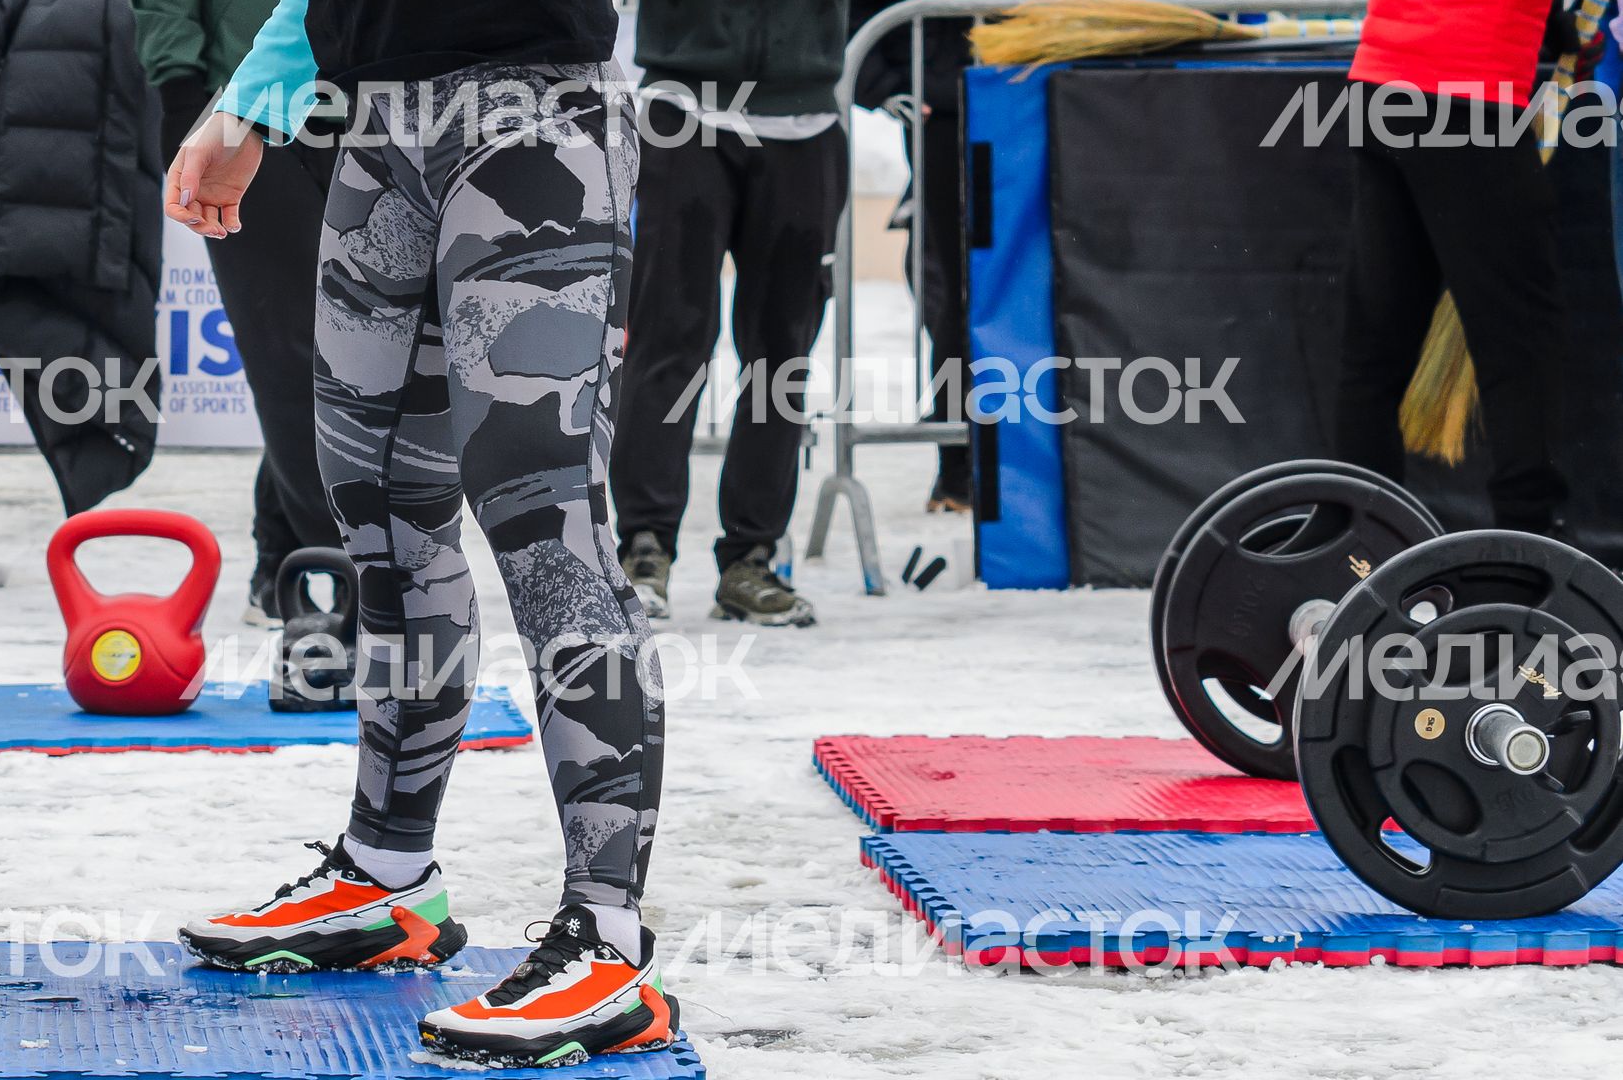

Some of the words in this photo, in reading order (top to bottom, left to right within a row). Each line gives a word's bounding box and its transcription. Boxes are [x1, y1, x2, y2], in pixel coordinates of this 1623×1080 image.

[156, 308, 245, 377] IS
[171, 380, 247, 394] ASSISTANCE
[169, 396, 186, 413] OF
[192, 396, 247, 414] SPORTS
